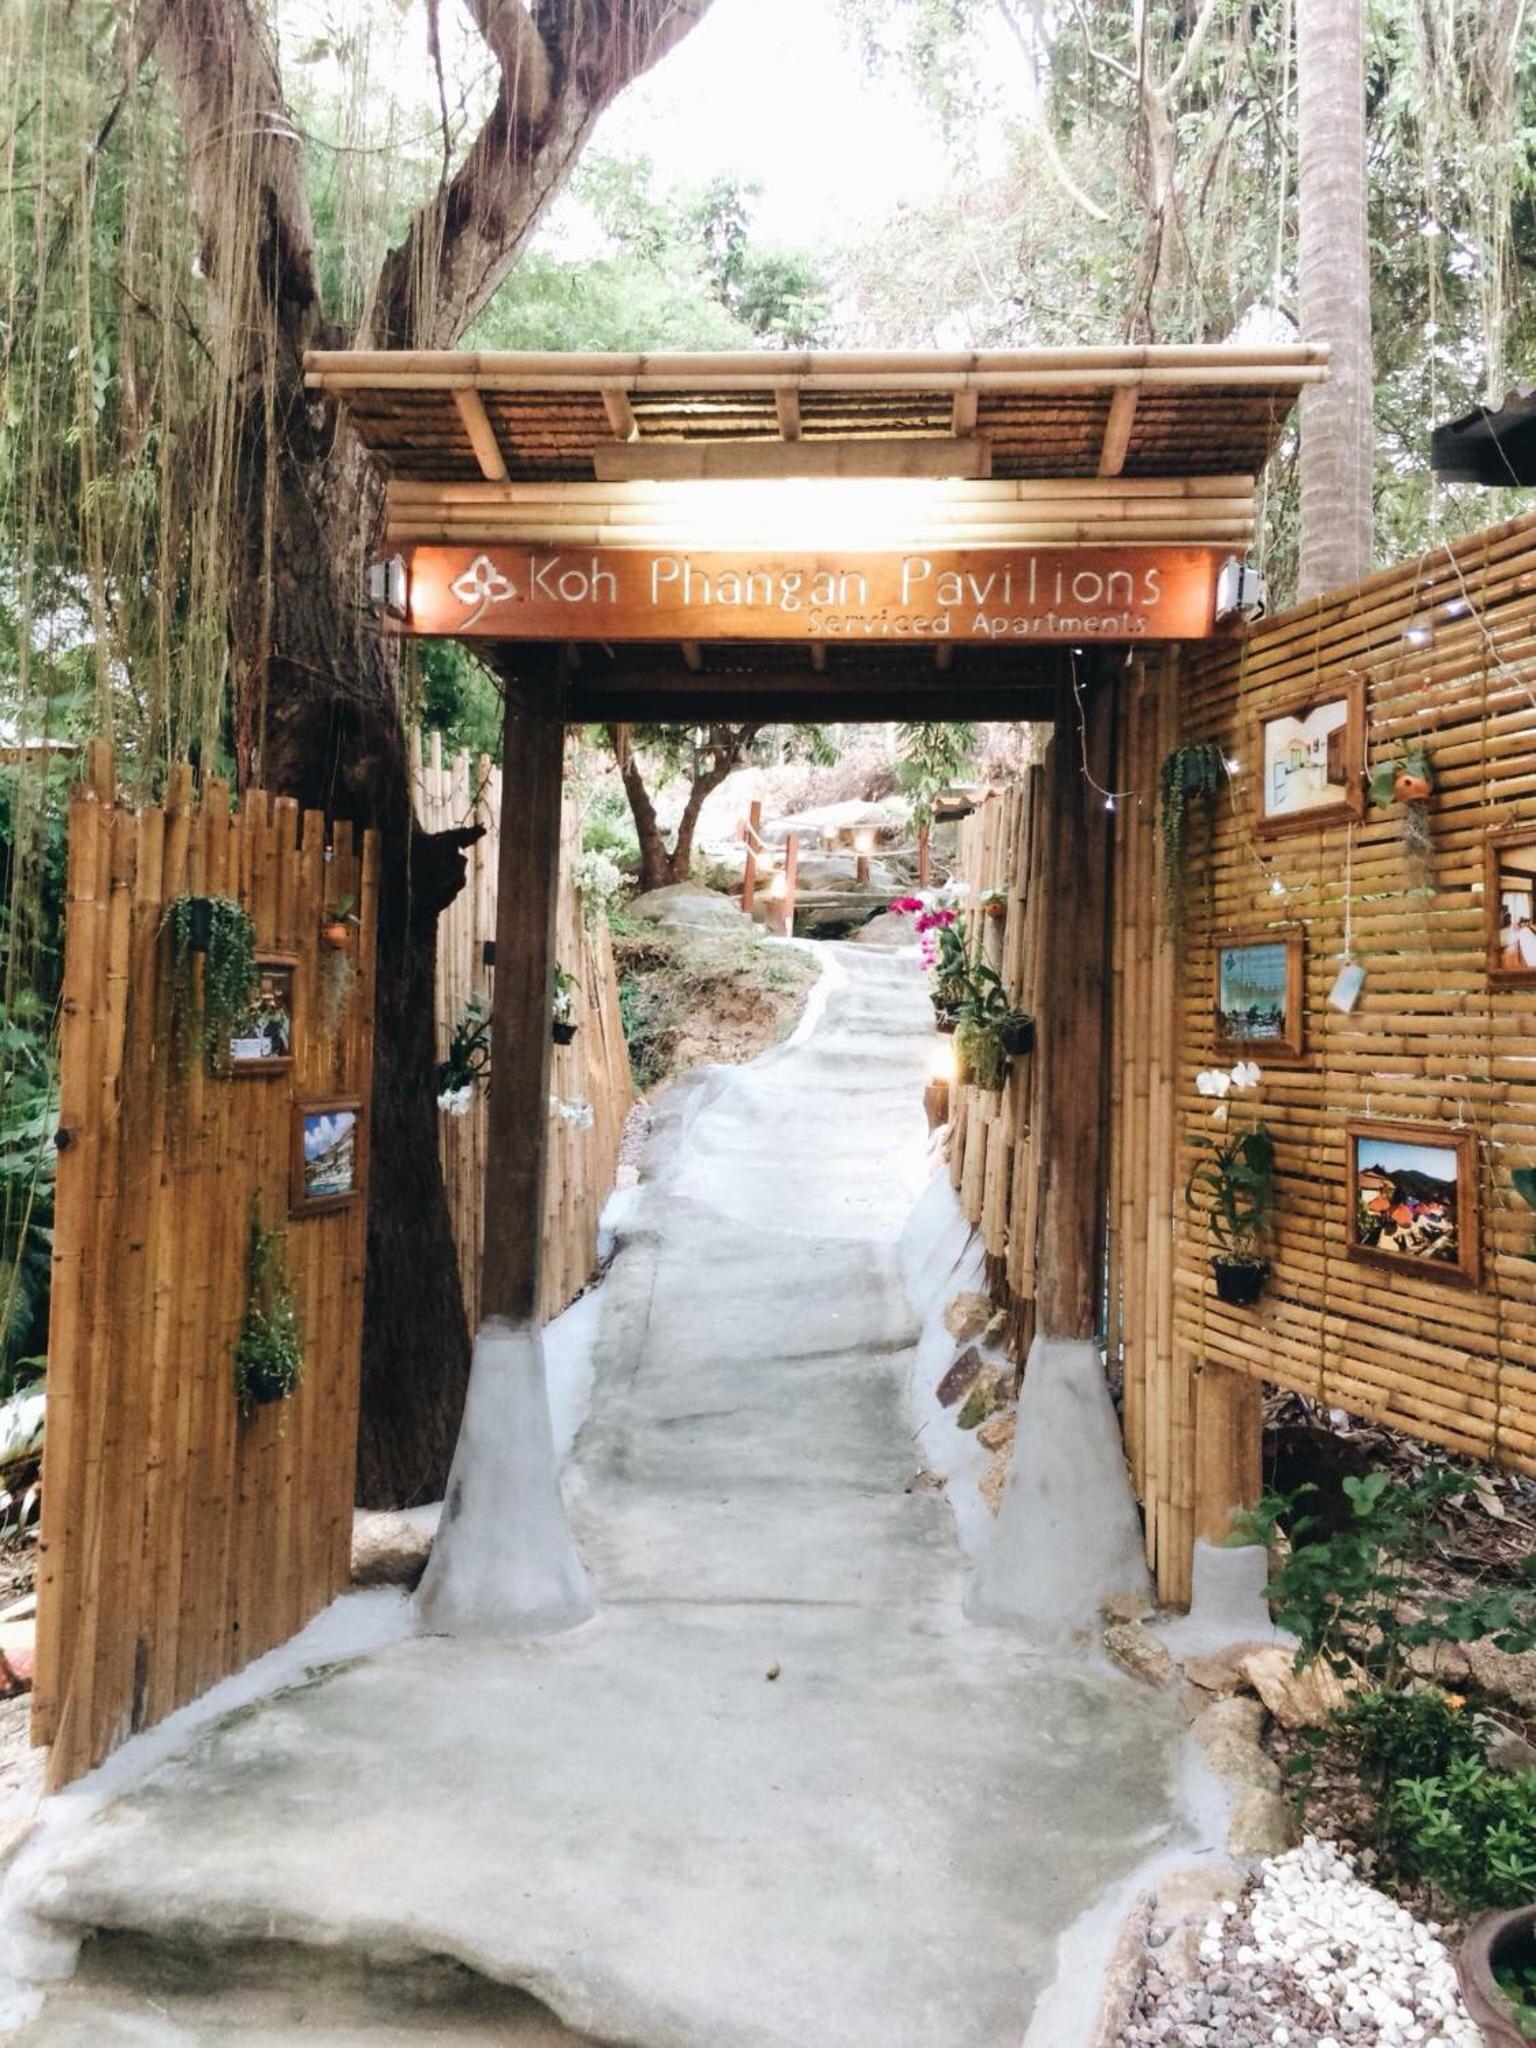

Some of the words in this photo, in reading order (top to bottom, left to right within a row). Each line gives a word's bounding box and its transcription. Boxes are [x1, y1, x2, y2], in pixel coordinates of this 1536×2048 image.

[529, 556, 618, 603] Koh
[650, 556, 867, 612] Phangan
[902, 555, 1162, 605] Pavilions
[807, 607, 951, 635] Serviced
[972, 611, 1149, 637] Apartments
